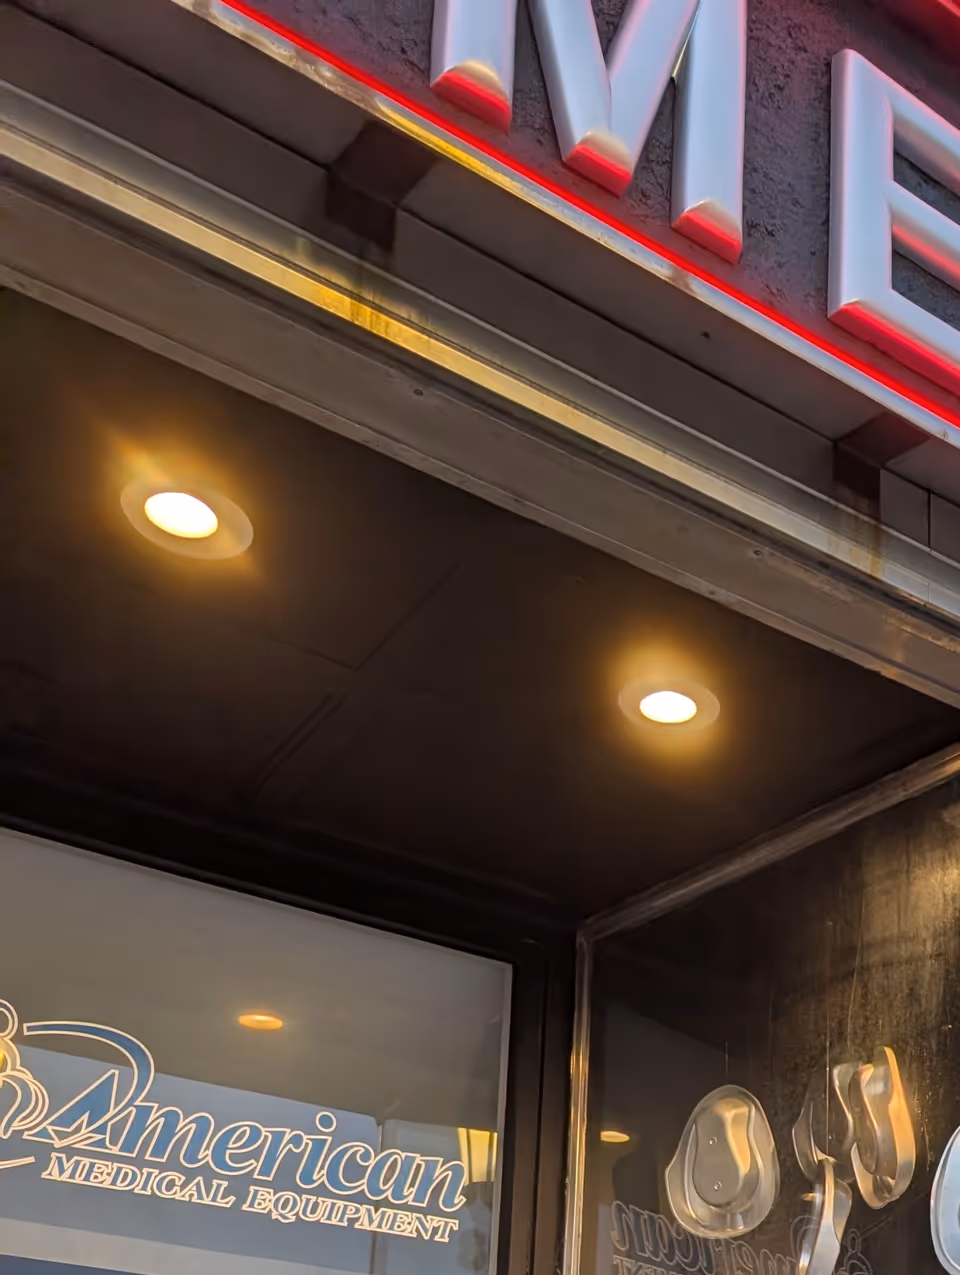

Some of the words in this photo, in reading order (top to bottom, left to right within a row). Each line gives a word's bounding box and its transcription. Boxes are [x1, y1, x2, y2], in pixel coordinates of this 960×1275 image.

[23, 1020, 467, 1212] American
[42, 1153, 235, 1208] MEDICAL
[243, 1186, 459, 1242] EQUIPMENT
